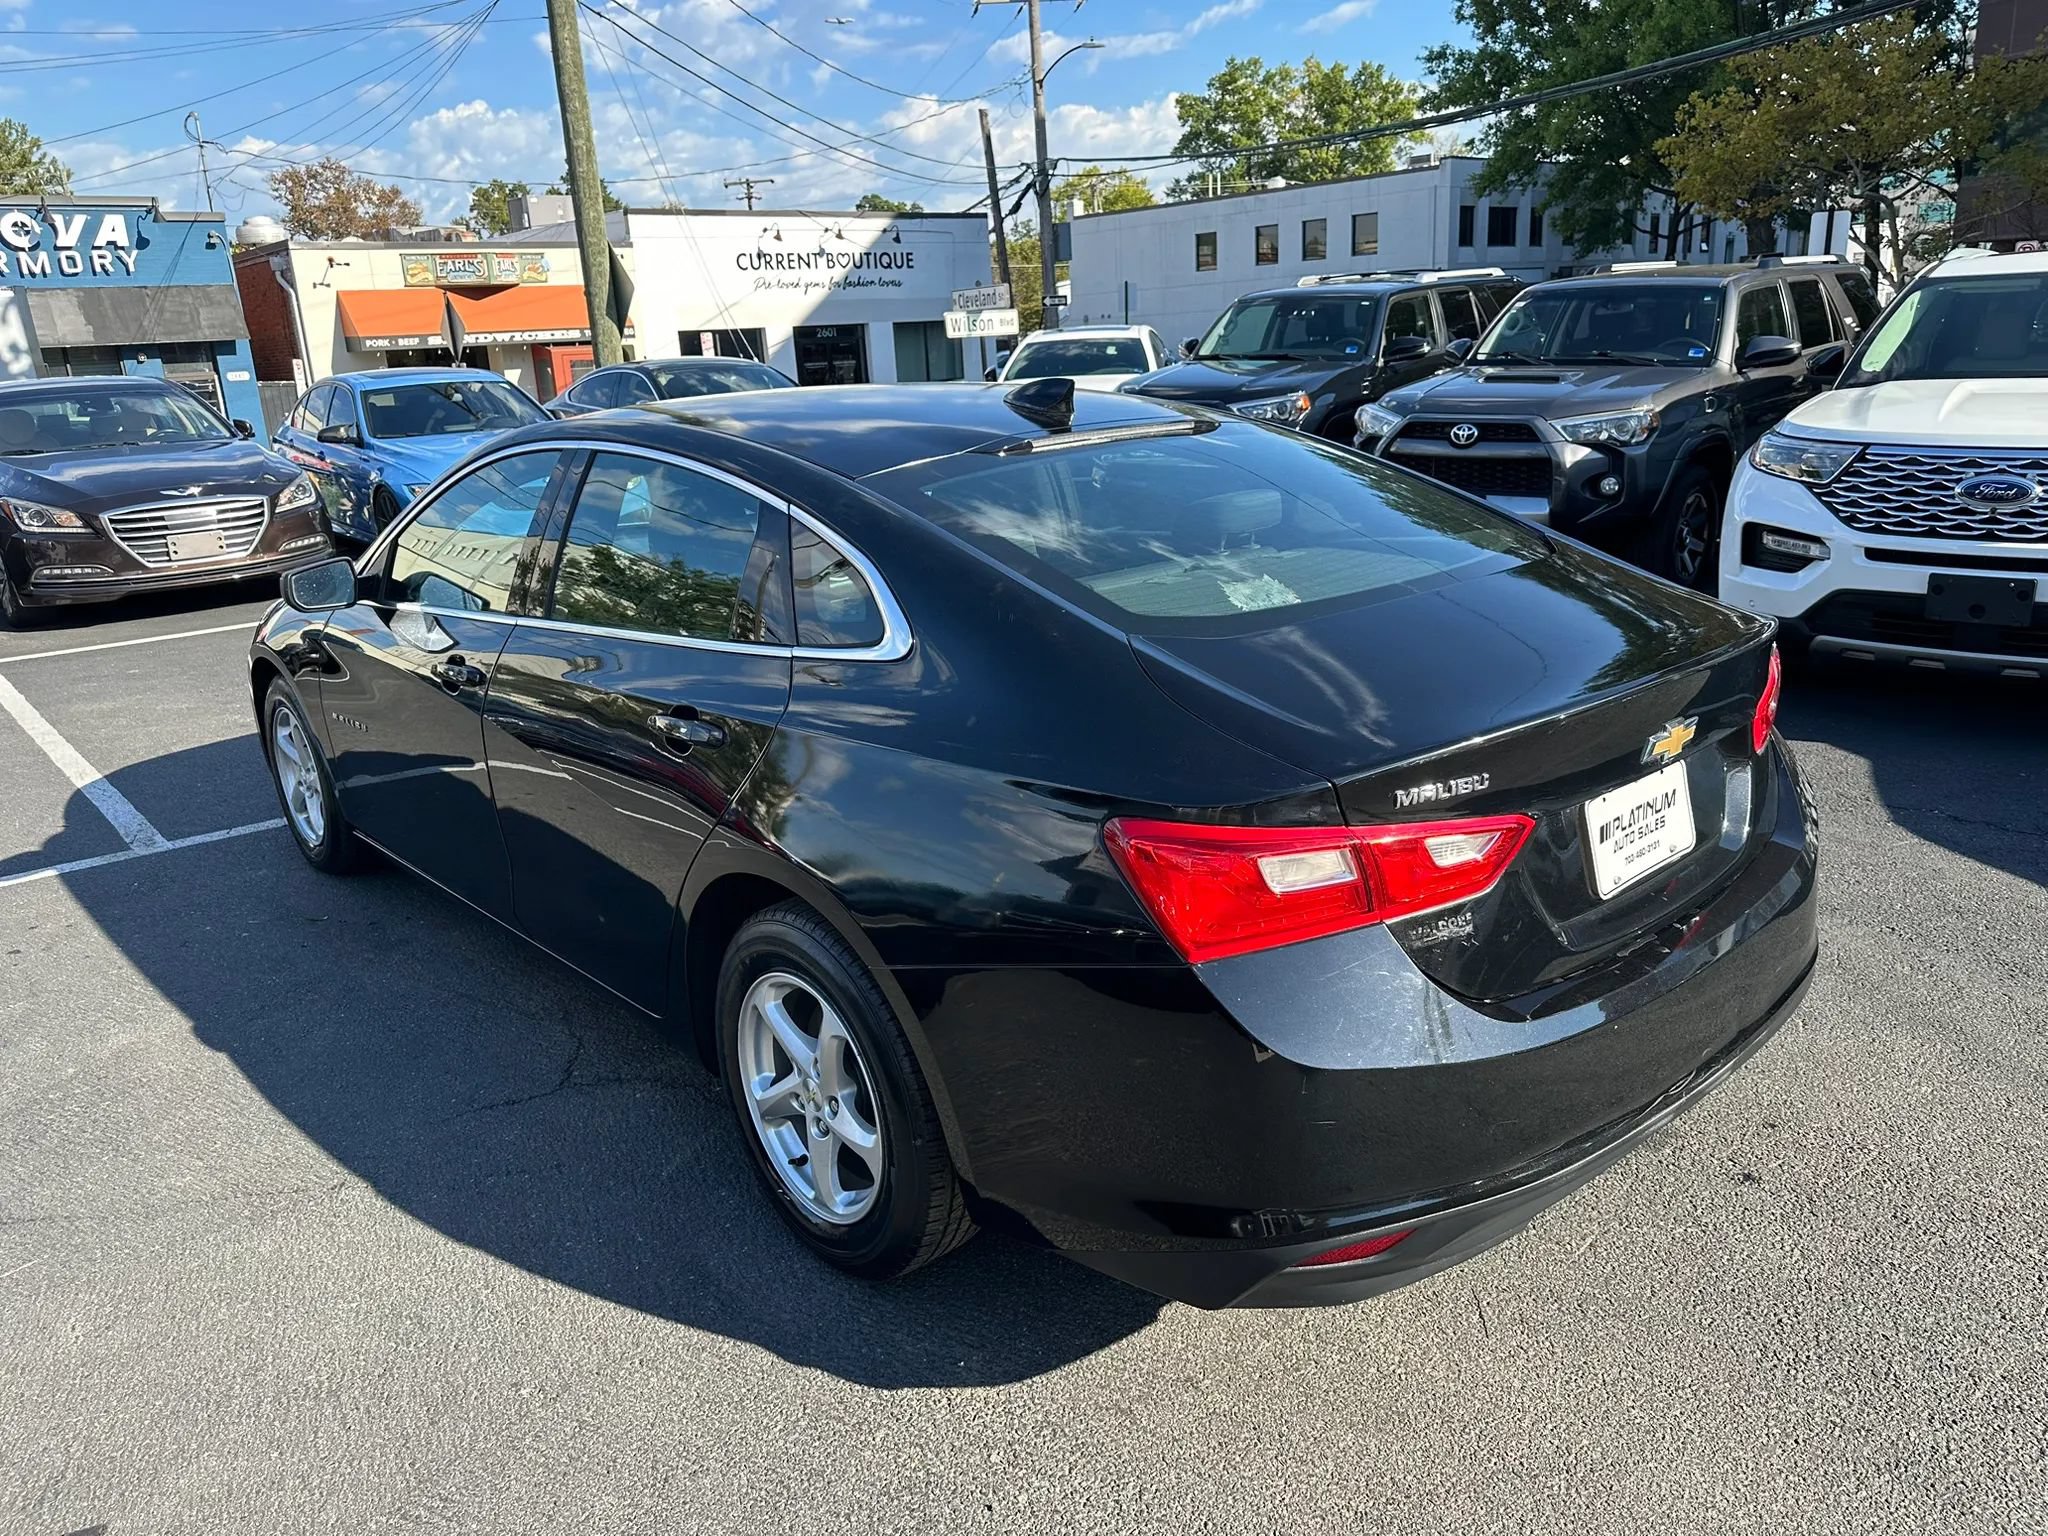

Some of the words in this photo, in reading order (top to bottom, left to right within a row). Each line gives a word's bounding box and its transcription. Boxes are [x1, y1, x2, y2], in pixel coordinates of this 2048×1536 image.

[437, 259, 485, 277] EARL'S
[736, 252, 820, 271] CURRENT
[753, 276, 802, 291] Pre-loved
[804, 281, 826, 295] gems
[842, 275, 877, 291] fashion
[878, 276, 903, 289] lovers
[957, 288, 997, 309] Cleveland
[816, 327, 838, 338] 2601
[950, 315, 994, 333] Wilson
[999, 317, 1014, 327] Blvd
[365, 338, 390, 348] PORK
[398, 337, 419, 346] BEEF
[427, 329, 581, 346] SNDWICHES
[1975, 482, 2018, 499] Ford
[1394, 772, 1490, 810] MALIBU
[1612, 788, 1677, 837] PLATINUM
[1613, 830, 1635, 854] AUTO
[1637, 815, 1666, 840] SALES
